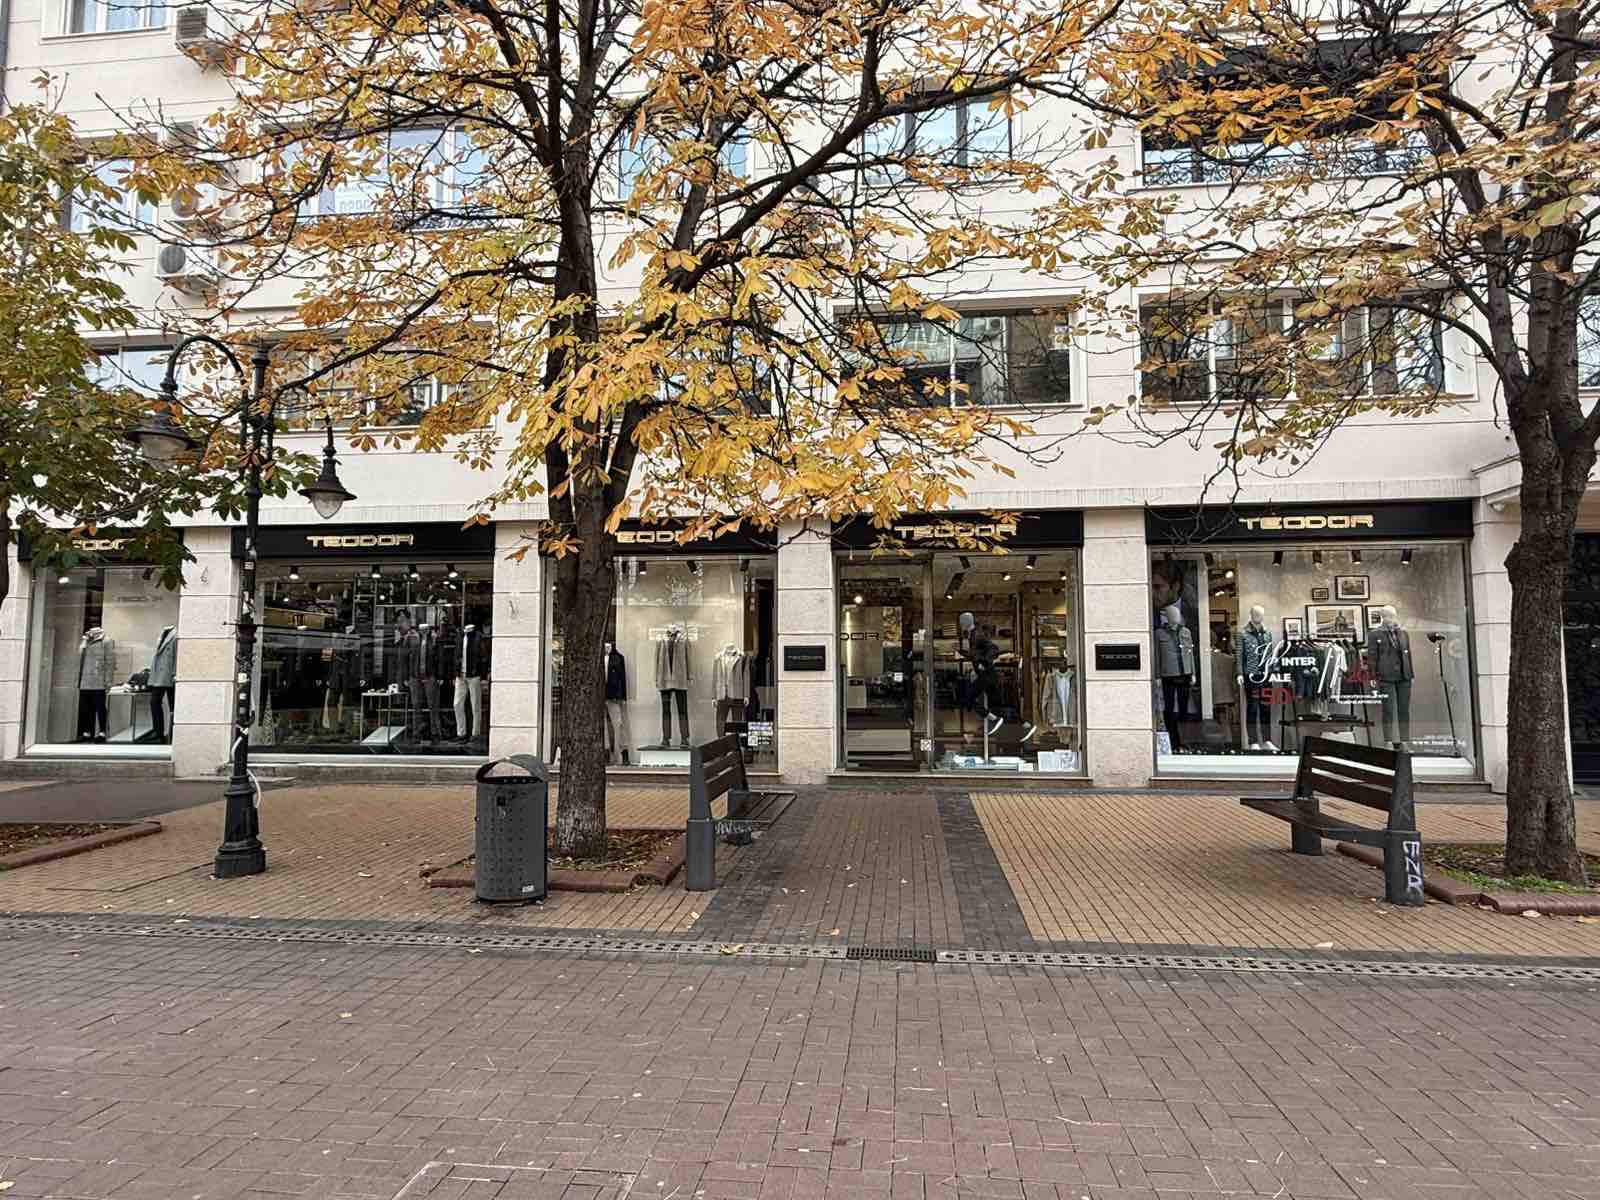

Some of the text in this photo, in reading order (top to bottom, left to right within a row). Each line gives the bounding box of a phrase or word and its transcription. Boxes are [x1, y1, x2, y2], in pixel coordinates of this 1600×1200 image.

[1238, 514, 1375, 530] TEODOR
[306, 534, 414, 548] TEODOR
[613, 529, 713, 544] EODR
[1255, 640, 1316, 667] WINTER
